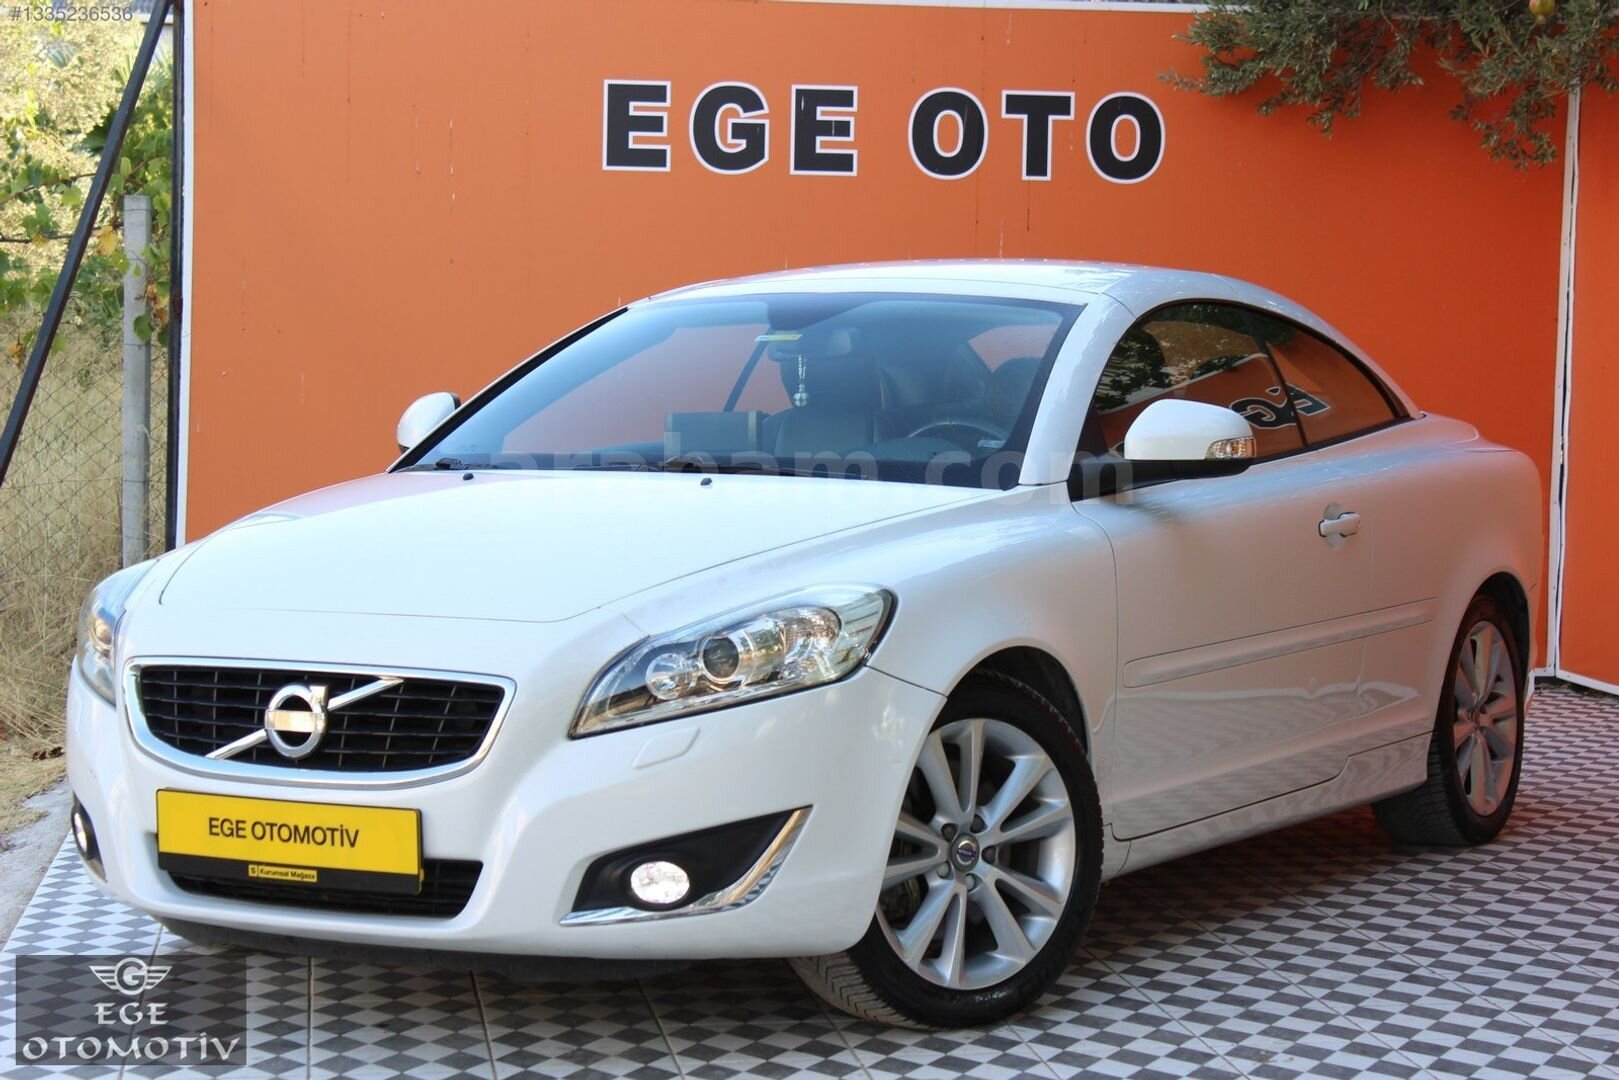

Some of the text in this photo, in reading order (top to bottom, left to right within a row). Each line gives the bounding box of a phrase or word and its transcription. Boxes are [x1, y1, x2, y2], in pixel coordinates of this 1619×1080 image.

[602, 79, 1166, 184] EGE OTO
[208, 816, 360, 848] EGE OTOMOTİV
[259, 867, 289, 879] Kurumsal
